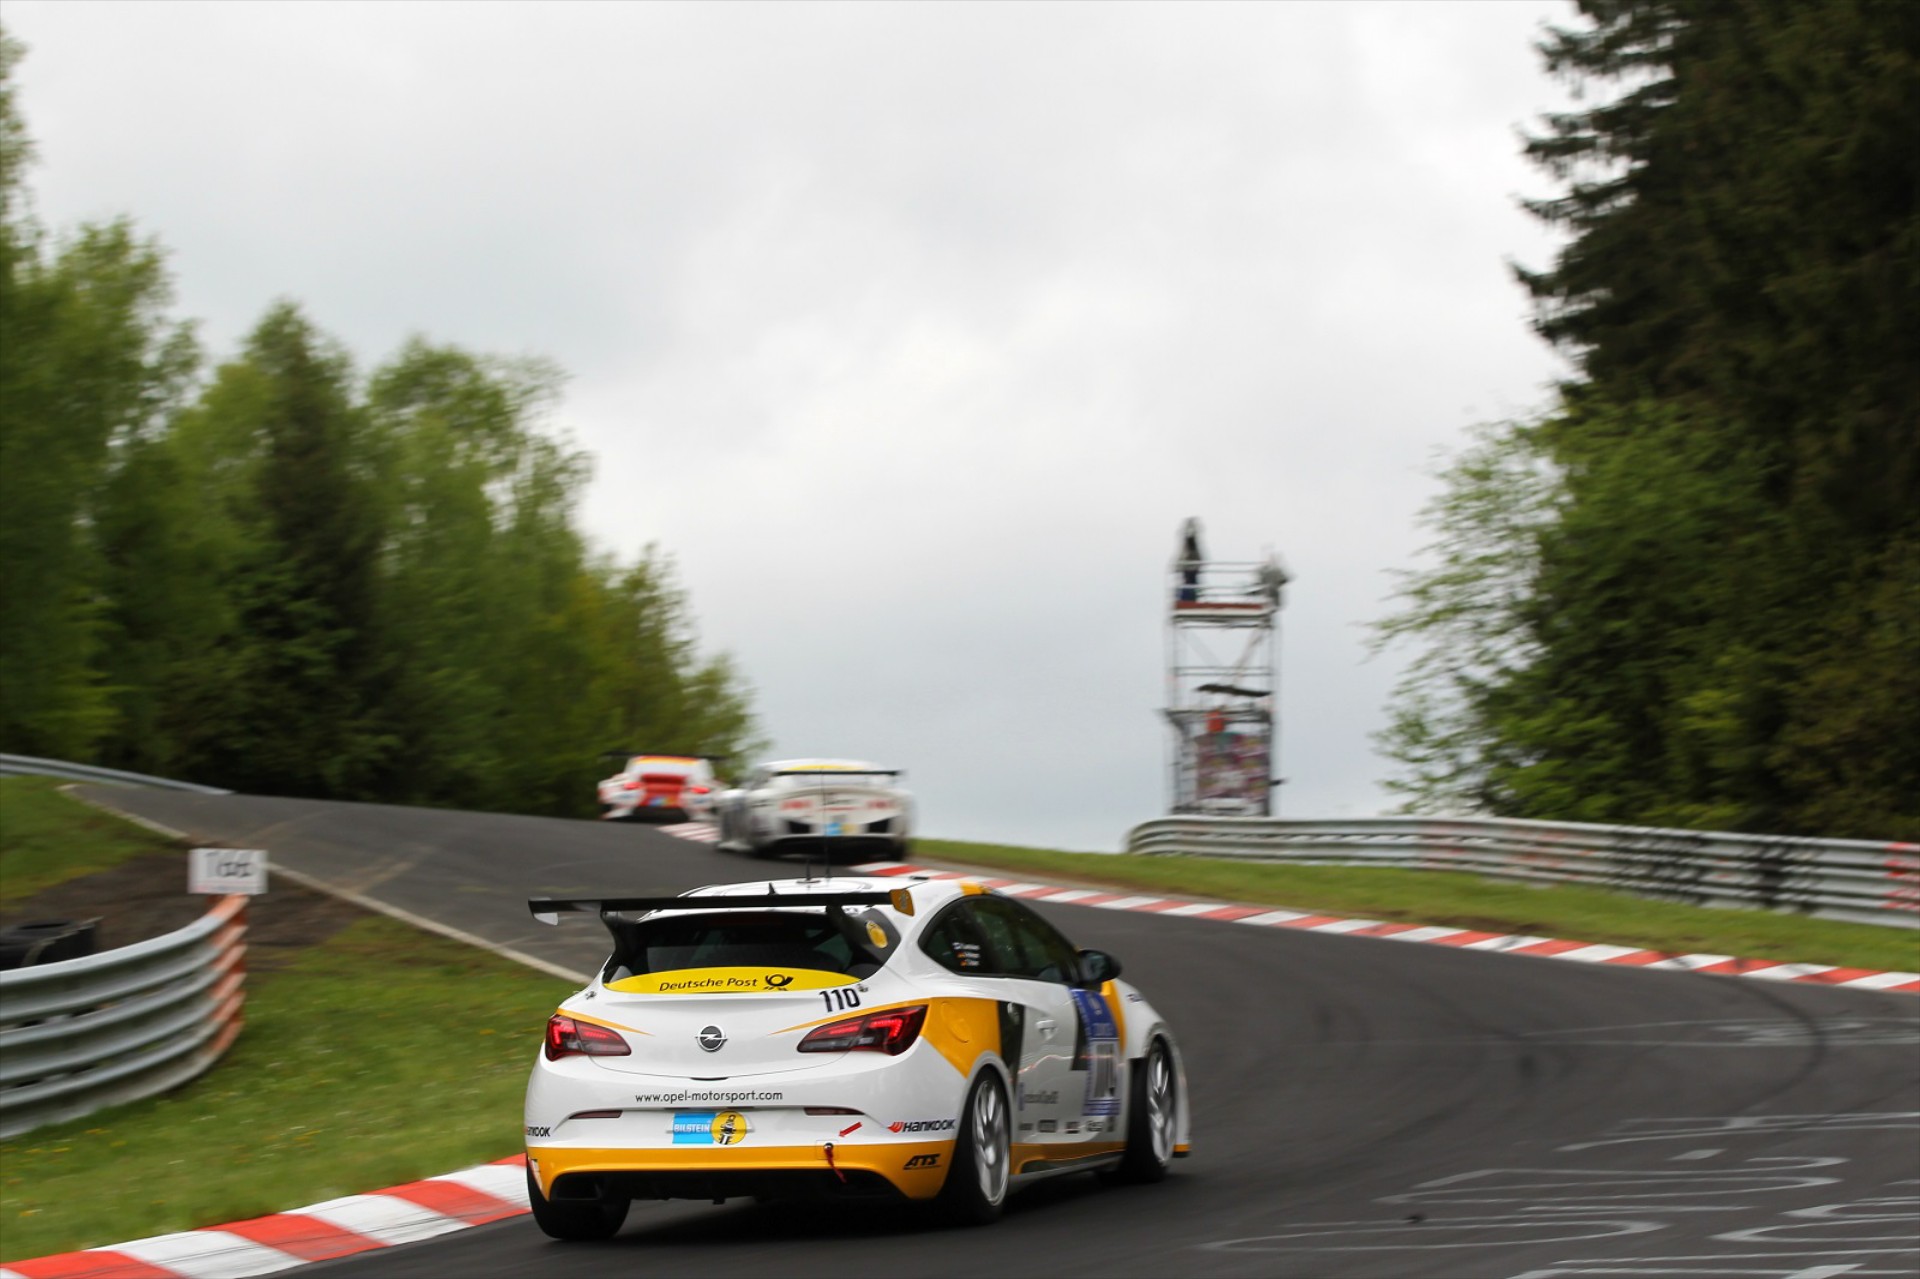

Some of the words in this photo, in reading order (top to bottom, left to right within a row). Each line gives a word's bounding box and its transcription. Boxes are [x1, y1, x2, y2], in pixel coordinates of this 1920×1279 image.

[659, 976, 723, 992] Deutsche
[726, 977, 758, 987] Post
[819, 988, 861, 1013] 110
[635, 1090, 783, 1104] www.opel-motorsport.com
[673, 1123, 711, 1134] BILSTEIN
[903, 1153, 941, 1171] ATS
